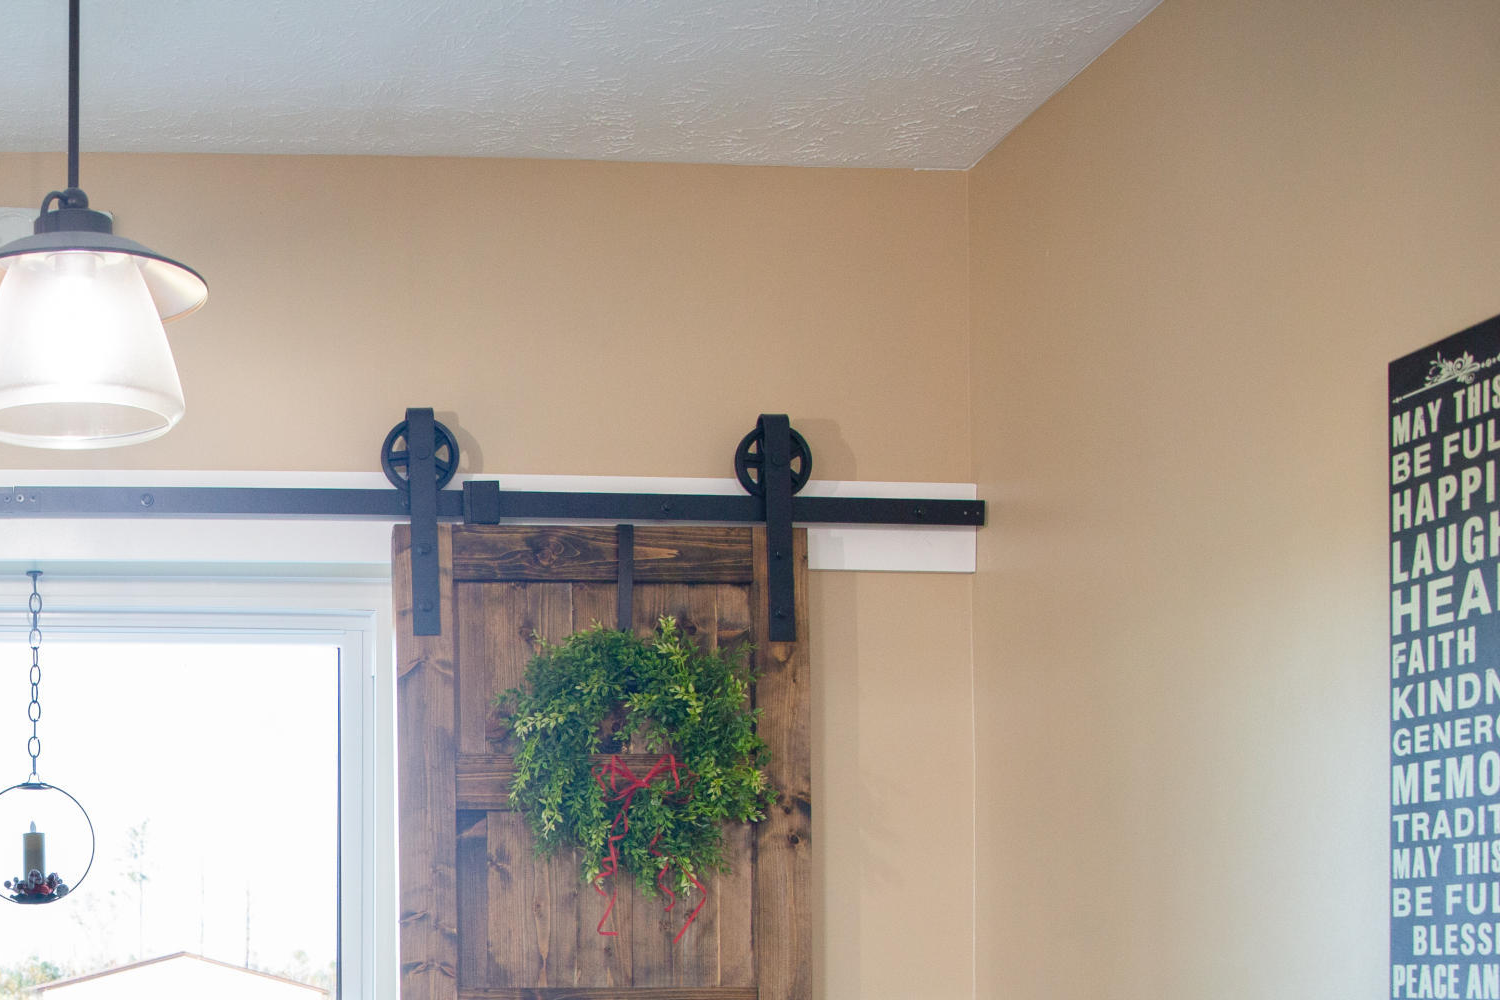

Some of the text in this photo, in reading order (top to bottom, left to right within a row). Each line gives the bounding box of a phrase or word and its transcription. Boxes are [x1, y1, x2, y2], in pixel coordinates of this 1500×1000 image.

[1392, 374, 1500, 448] MAY THIS
[1392, 418, 1500, 486] BE FUL
[1392, 460, 1495, 533] HAPPI
[1392, 562, 1500, 636] HEA
[1392, 626, 1476, 679] FAITH
[1392, 668, 1500, 721] KINDN
[1392, 714, 1500, 757] GENER
[1392, 750, 1500, 806] MEMO
[1392, 803, 1500, 843] TRADIT
[1392, 839, 1500, 880] MAY THIS
[1392, 886, 1433, 917] BE
[1392, 963, 1500, 1000] PEACE AN
